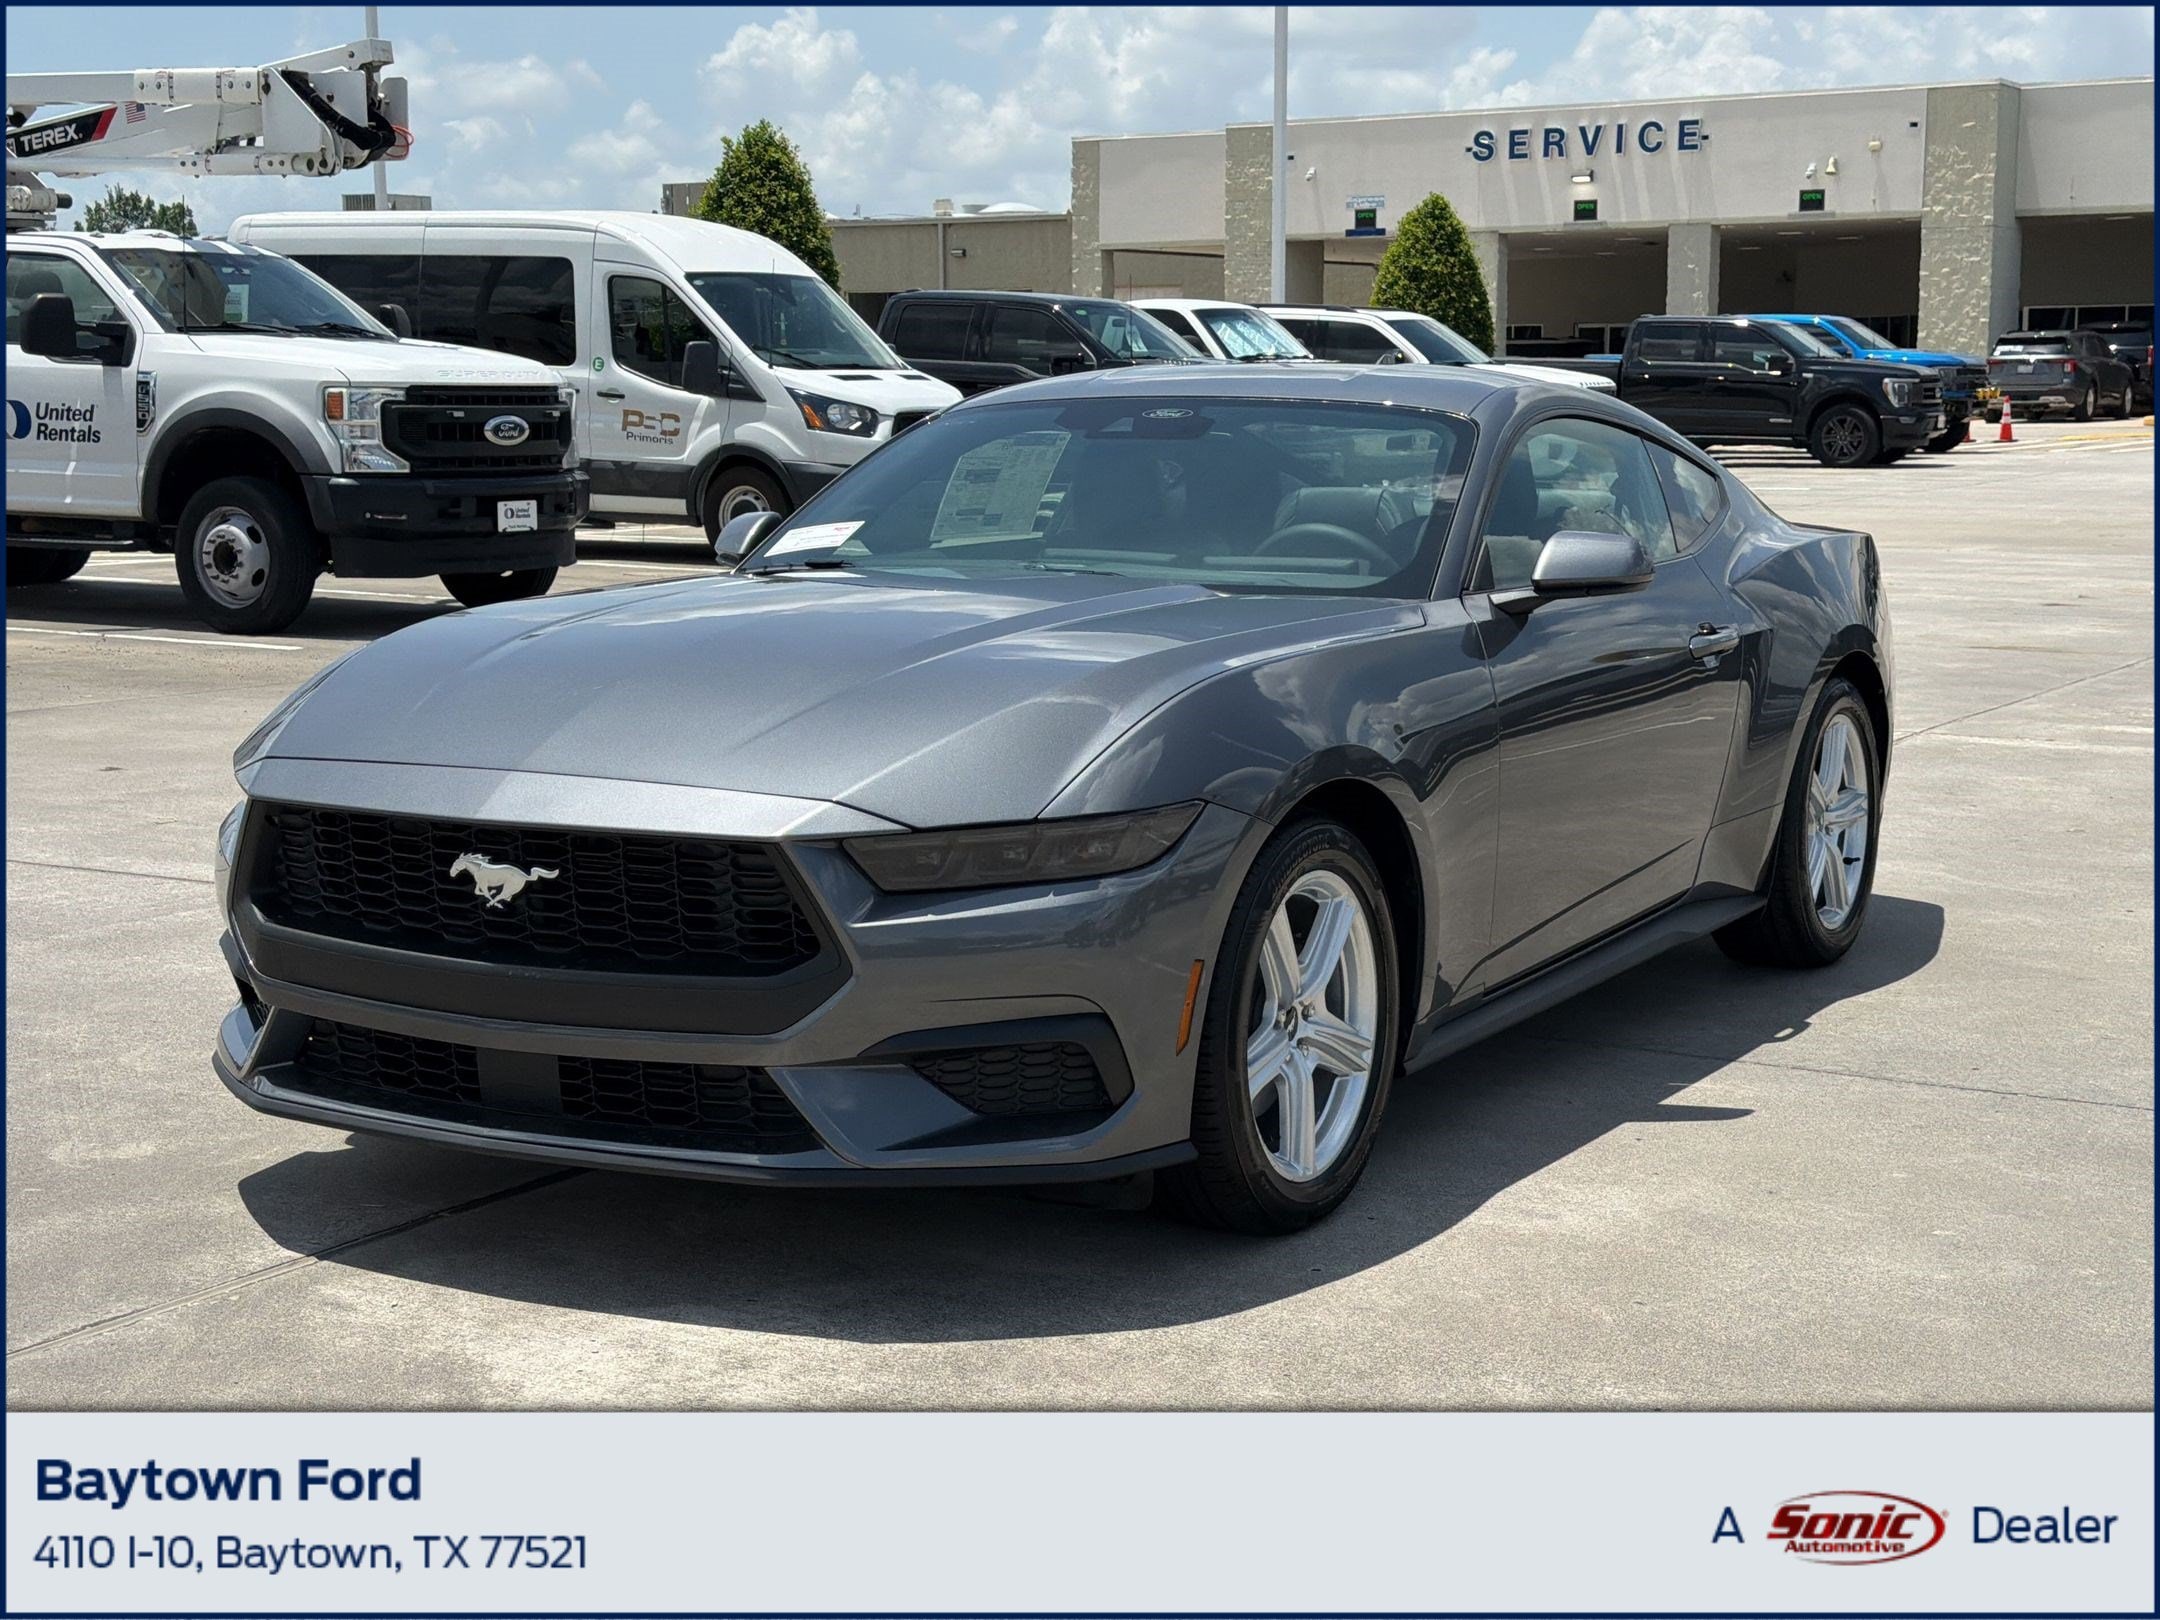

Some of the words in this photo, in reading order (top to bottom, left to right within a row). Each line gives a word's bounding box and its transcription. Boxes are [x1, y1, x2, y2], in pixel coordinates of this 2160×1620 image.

[20, 123, 80, 152] TEREX
[1472, 119, 1701, 162] SERVICE
[438, 369, 497, 378] SUPER
[502, 369, 541, 378] DUTY
[35, 402, 95, 422] United
[1150, 409, 1186, 417] Ford
[36, 423, 101, 444] Rentals
[498, 423, 520, 438] Ford
[626, 431, 674, 445] Primoris
